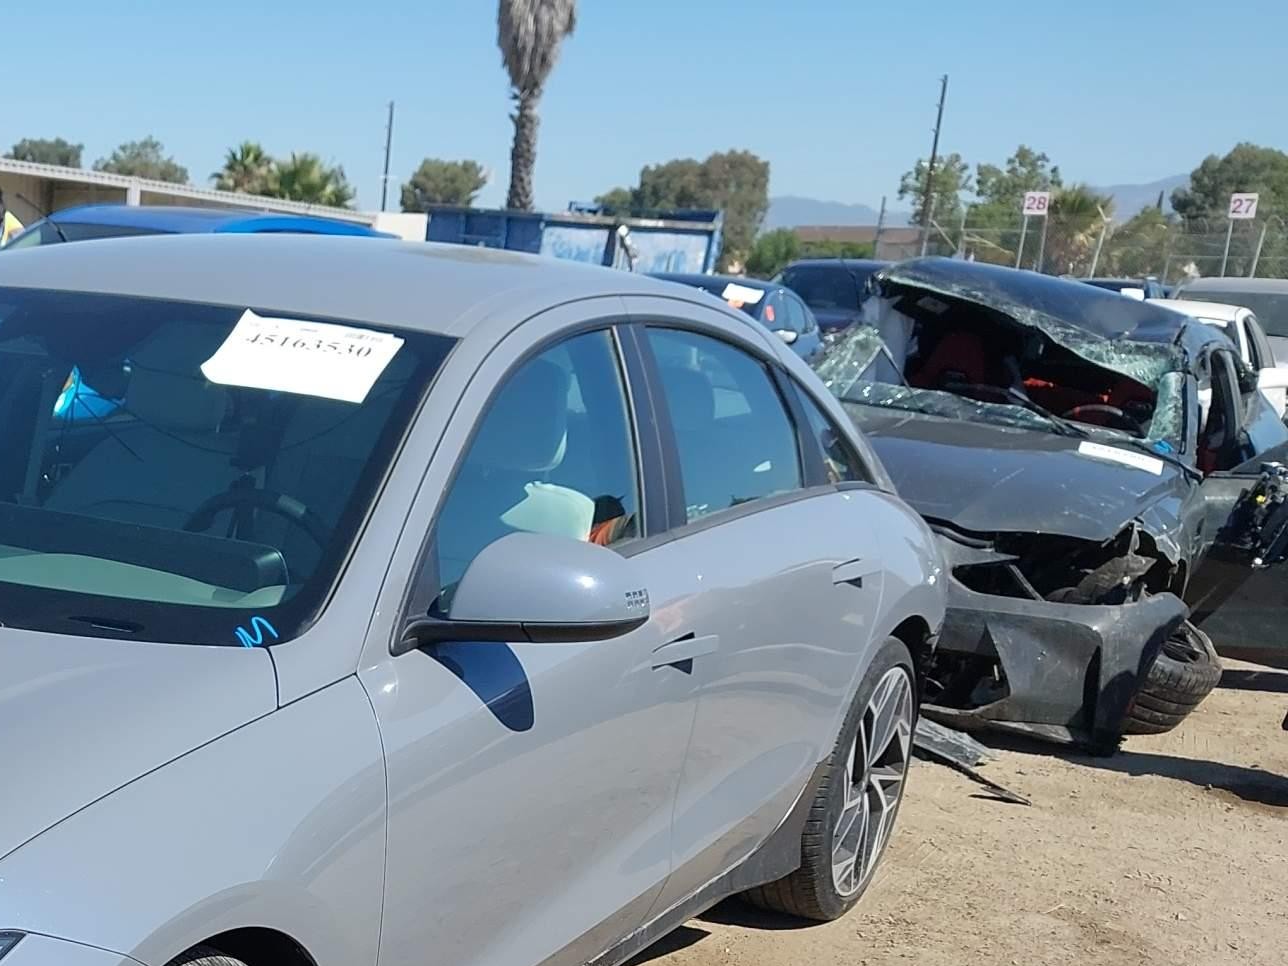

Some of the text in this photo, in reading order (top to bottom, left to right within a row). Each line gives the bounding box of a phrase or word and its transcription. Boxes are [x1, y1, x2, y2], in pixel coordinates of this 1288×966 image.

[1026, 196, 1047, 210] 28
[1232, 198, 1256, 213] 27
[244, 332, 373, 358] 45163530
